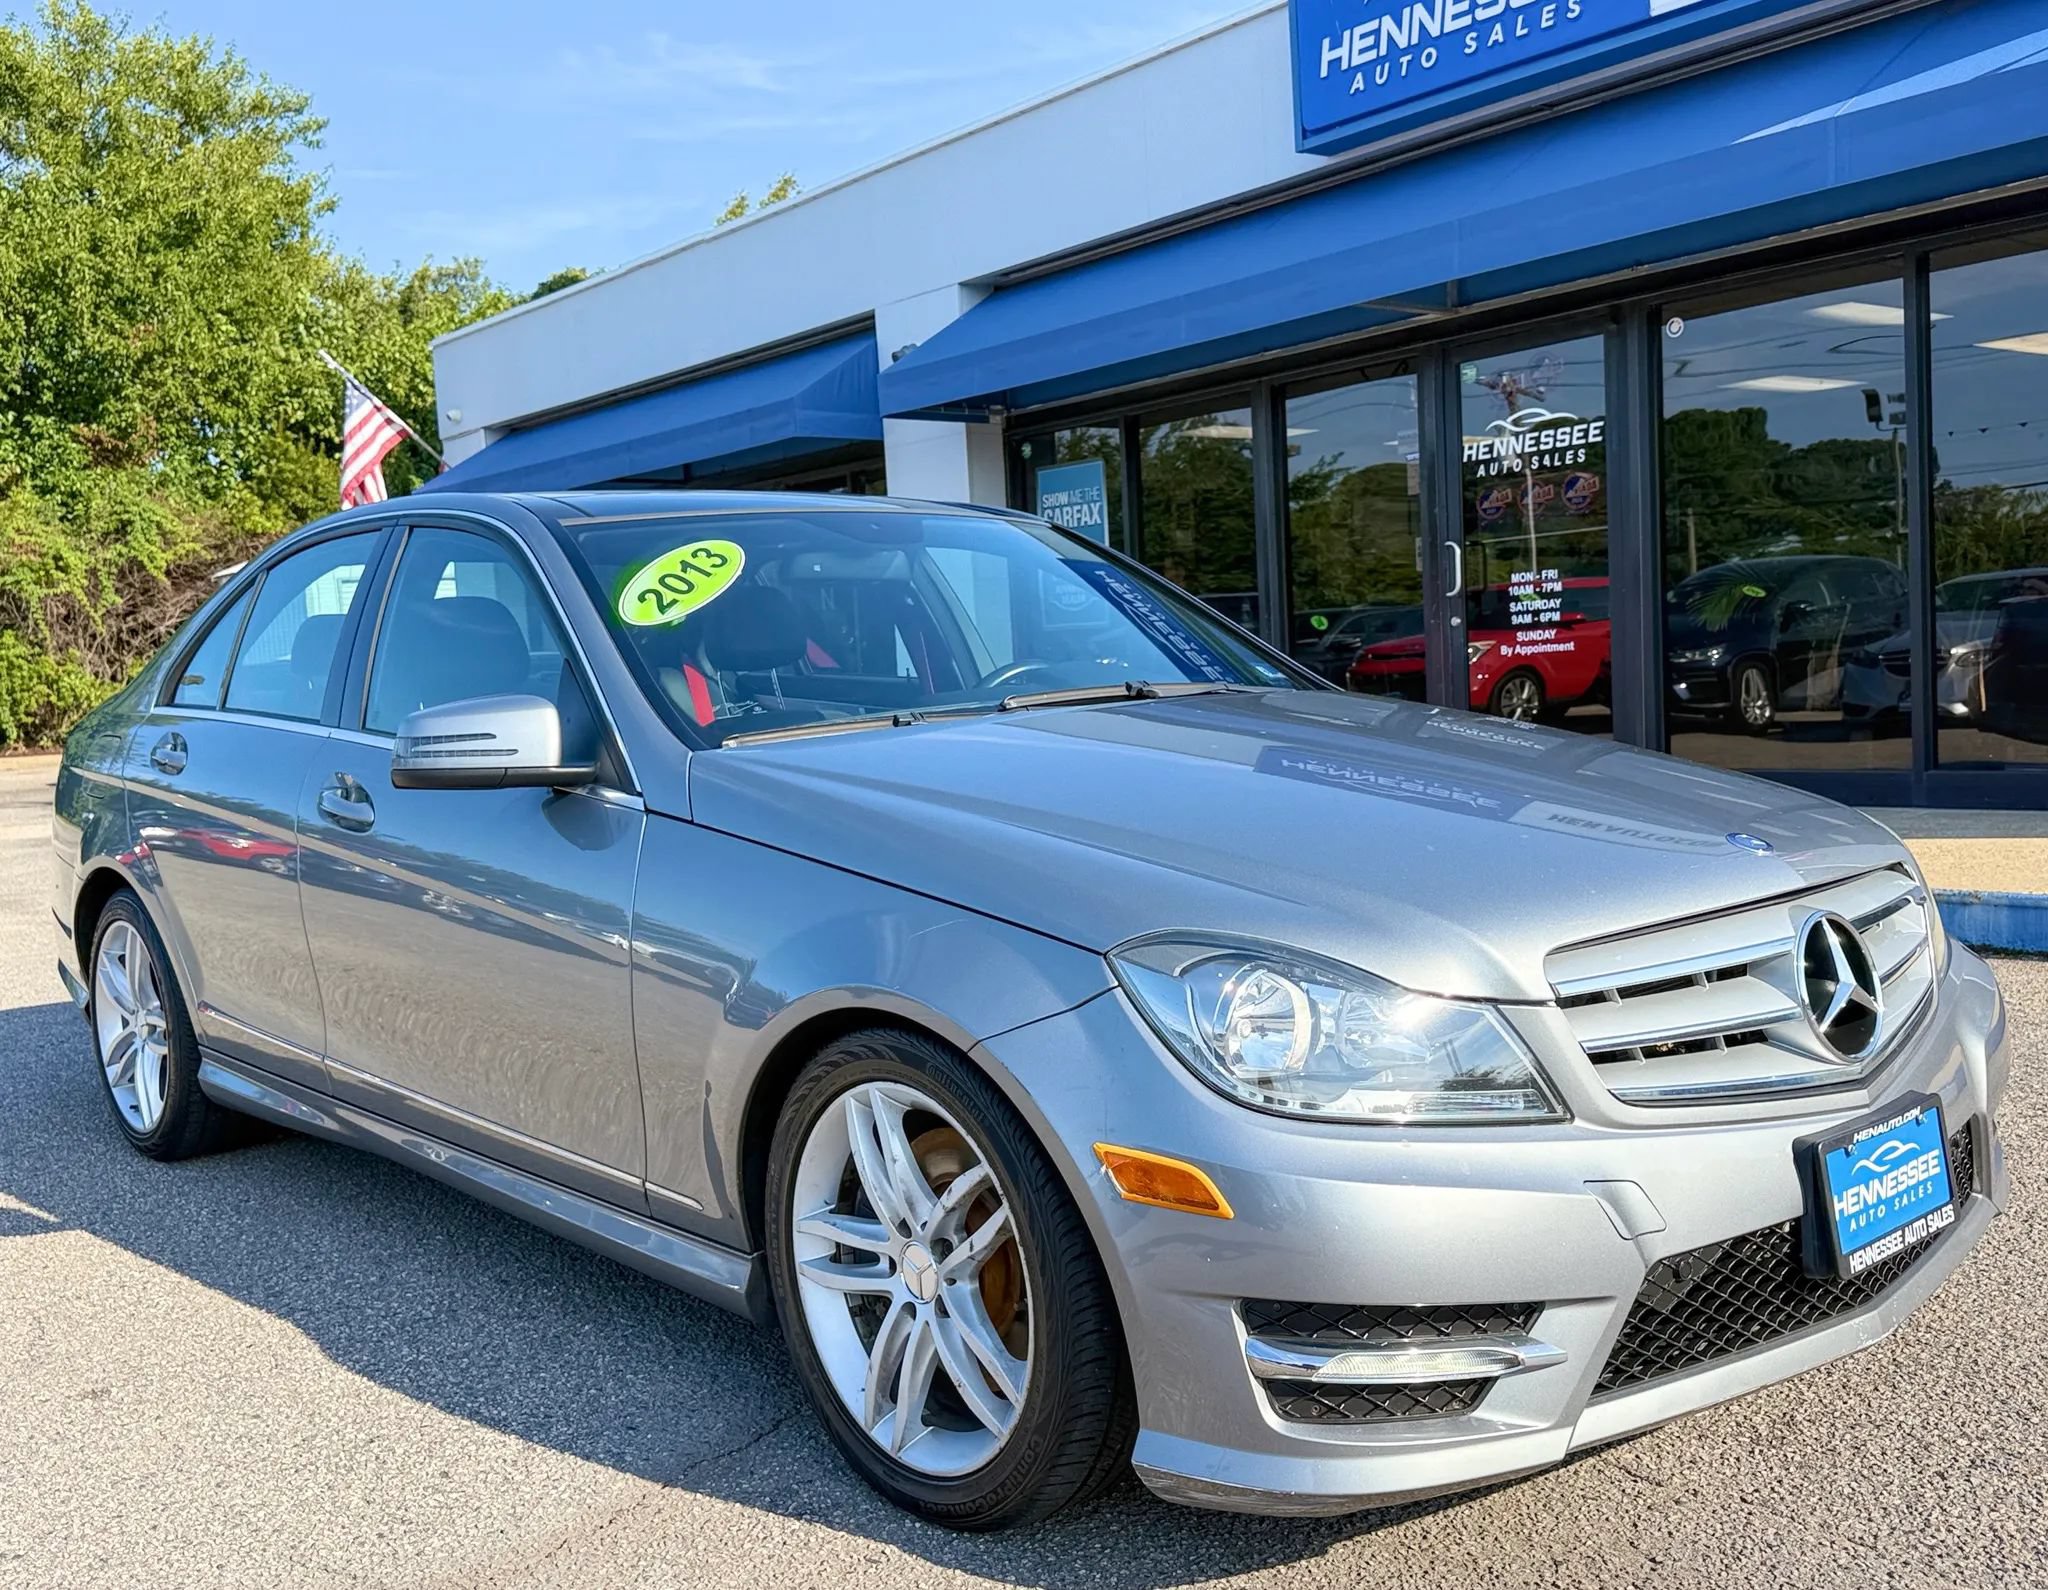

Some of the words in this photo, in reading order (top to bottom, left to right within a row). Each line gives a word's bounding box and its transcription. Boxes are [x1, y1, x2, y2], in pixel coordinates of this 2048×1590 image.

[1349, 47, 1438, 95] AUTO
[1463, 0, 1581, 54] SALES
[1462, 421, 1605, 463] HENNESSEE
[1476, 458, 1523, 478] AUTO
[1530, 448, 1586, 470] SALES
[1042, 490, 1069, 508] SHOW
[1069, 488, 1083, 503] ME
[1084, 486, 1100, 501] THE
[1043, 502, 1103, 528] CARFAX
[637, 547, 728, 615] 2013
[1508, 584, 1534, 596] 10AM
[1541, 581, 1563, 593] 7PM
[1510, 571, 1534, 583] MON
[1541, 569, 1558, 580] FRI
[1509, 598, 1562, 613] SATURDAY
[1510, 613, 1533, 625] 9AM
[1539, 611, 1561, 622] 6PM
[1500, 645, 1513, 658] By
[1514, 641, 1575, 656] Appointment
[1516, 629, 1558, 642] SUNDAY
[1853, 1105, 1921, 1144] HENAUTO.COM
[1833, 1148, 1941, 1222] HENNESSEE
[1850, 1204, 1886, 1232] AUTO
[1894, 1181, 1933, 1211] SALES
[1849, 1229, 1905, 1274] HENNESSEE
[1904, 1218, 1928, 1247] AUTO
[1926, 1203, 1955, 1234] SALES
